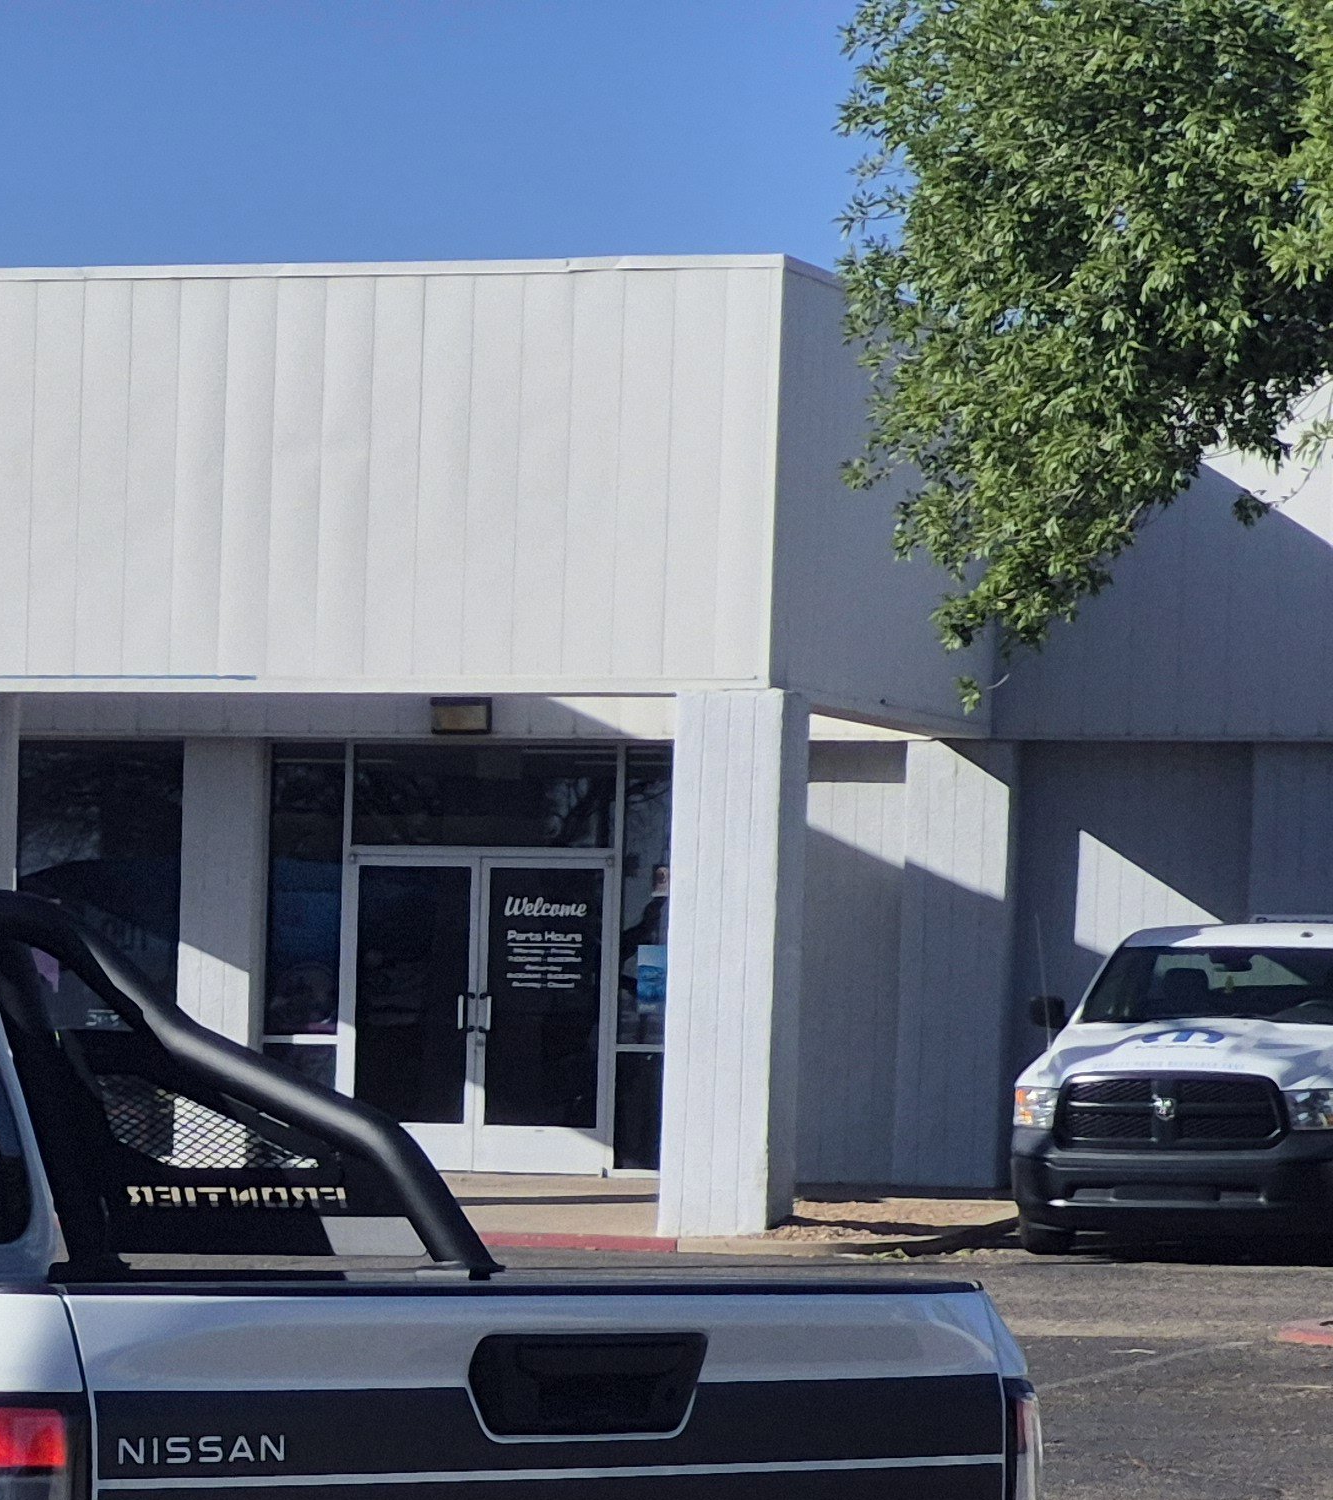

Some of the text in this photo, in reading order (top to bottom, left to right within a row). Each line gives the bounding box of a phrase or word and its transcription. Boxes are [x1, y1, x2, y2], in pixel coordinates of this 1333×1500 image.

[504, 896, 588, 917] Welcome
[507, 930, 582, 942] Parts Hours
[117, 1434, 285, 1465] NISSAN
